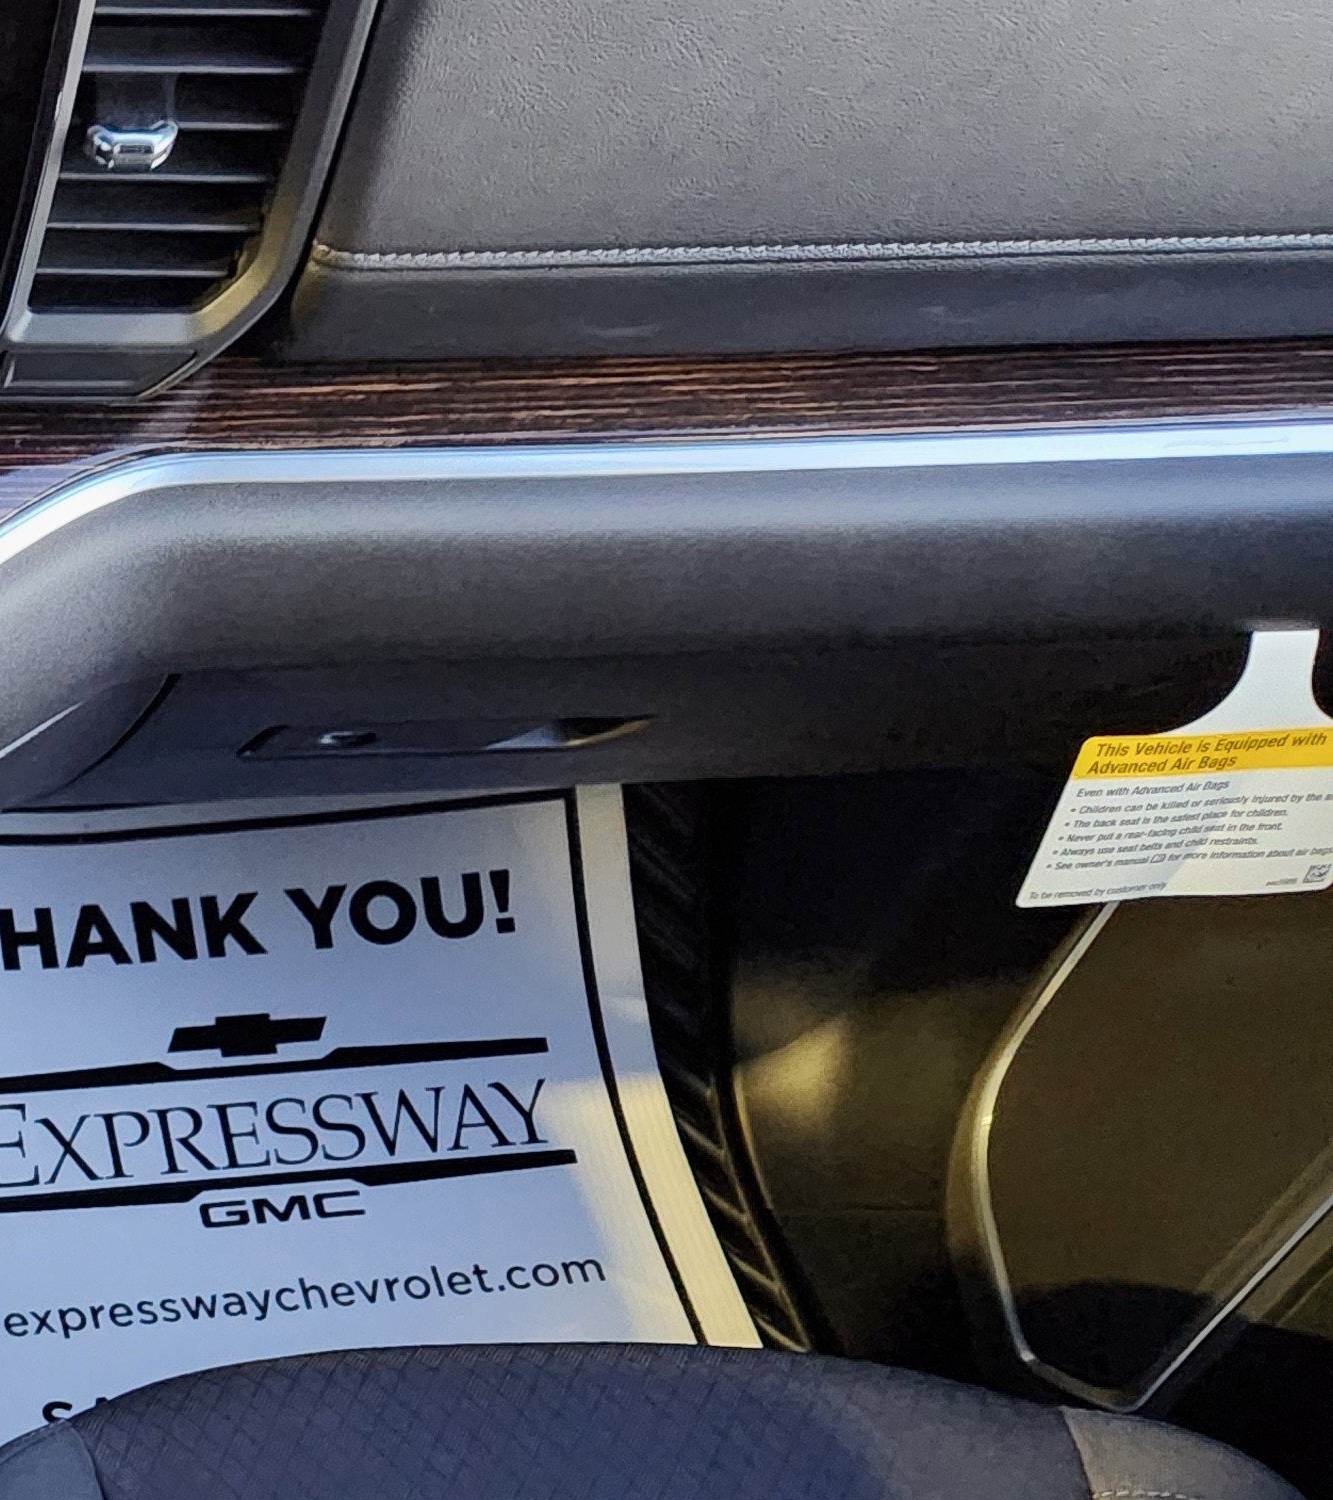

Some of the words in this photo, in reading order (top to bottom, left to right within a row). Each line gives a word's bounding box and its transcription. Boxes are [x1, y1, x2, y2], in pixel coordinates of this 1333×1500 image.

[1096, 743, 1128, 757] This
[1133, 740, 1192, 756] Vehicle
[1196, 738, 1211, 753] is
[1214, 734, 1289, 755] Equipped
[1292, 733, 1327, 747] with
[1086, 757, 1166, 775] Advanced
[1170, 757, 1194, 771] Air
[1198, 755, 1237, 772] Bags
[1076, 788, 1103, 797] Even
[1106, 787, 1129, 796] with
[1132, 783, 1183, 795] Advanced
[1185, 782, 1200, 792] Air
[1203, 781, 1230, 792] Bags
[1079, 805, 1121, 814] Children
[1124, 804, 1143, 813] can
[1145, 802, 1158, 811] be
[1160, 800, 1189, 810] killed
[1203, 796, 1249, 807] seriously
[1252, 794, 1290, 805] injured
[1291, 795, 1304, 804] by
[1305, 793, 1322, 801] the
[1073, 820, 1090, 828] The
[1093, 819, 1117, 827] back
[1119, 817, 1141, 826] seat
[1142, 816, 1151, 825] is
[1153, 815, 1168, 824] the
[1170, 812, 1200, 822] safest
[1201, 811, 1228, 822] place
[1230, 809, 1244, 818] for
[1066, 833, 1094, 842] Never
[1096, 832, 1113, 843] put
[1123, 827, 1178, 840] rear-facing
[1178, 825, 1203, 835] child
[1203, 824, 1225, 833] seat
[1227, 823, 1237, 832] in
[1239, 822, 1255, 832] the
[1060, 847, 1095, 857] Always
[1097, 846, 1114, 855] use
[1116, 844, 1139, 853] seat
[1139, 842, 1162, 851] belts
[1164, 840, 1183, 849] and
[1184, 838, 1208, 848] child
[1055, 861, 1073, 870] See
[1167, 853, 1181, 862] for
[1183, 851, 1207, 859] more
[1210, 849, 1265, 859] information
[1266, 848, 1294, 858] about
[284, 868, 519, 951] YOU!
[199, 1190, 367, 1230] GMC
[3, 1251, 607, 1339] expresswaychevrolet.com
